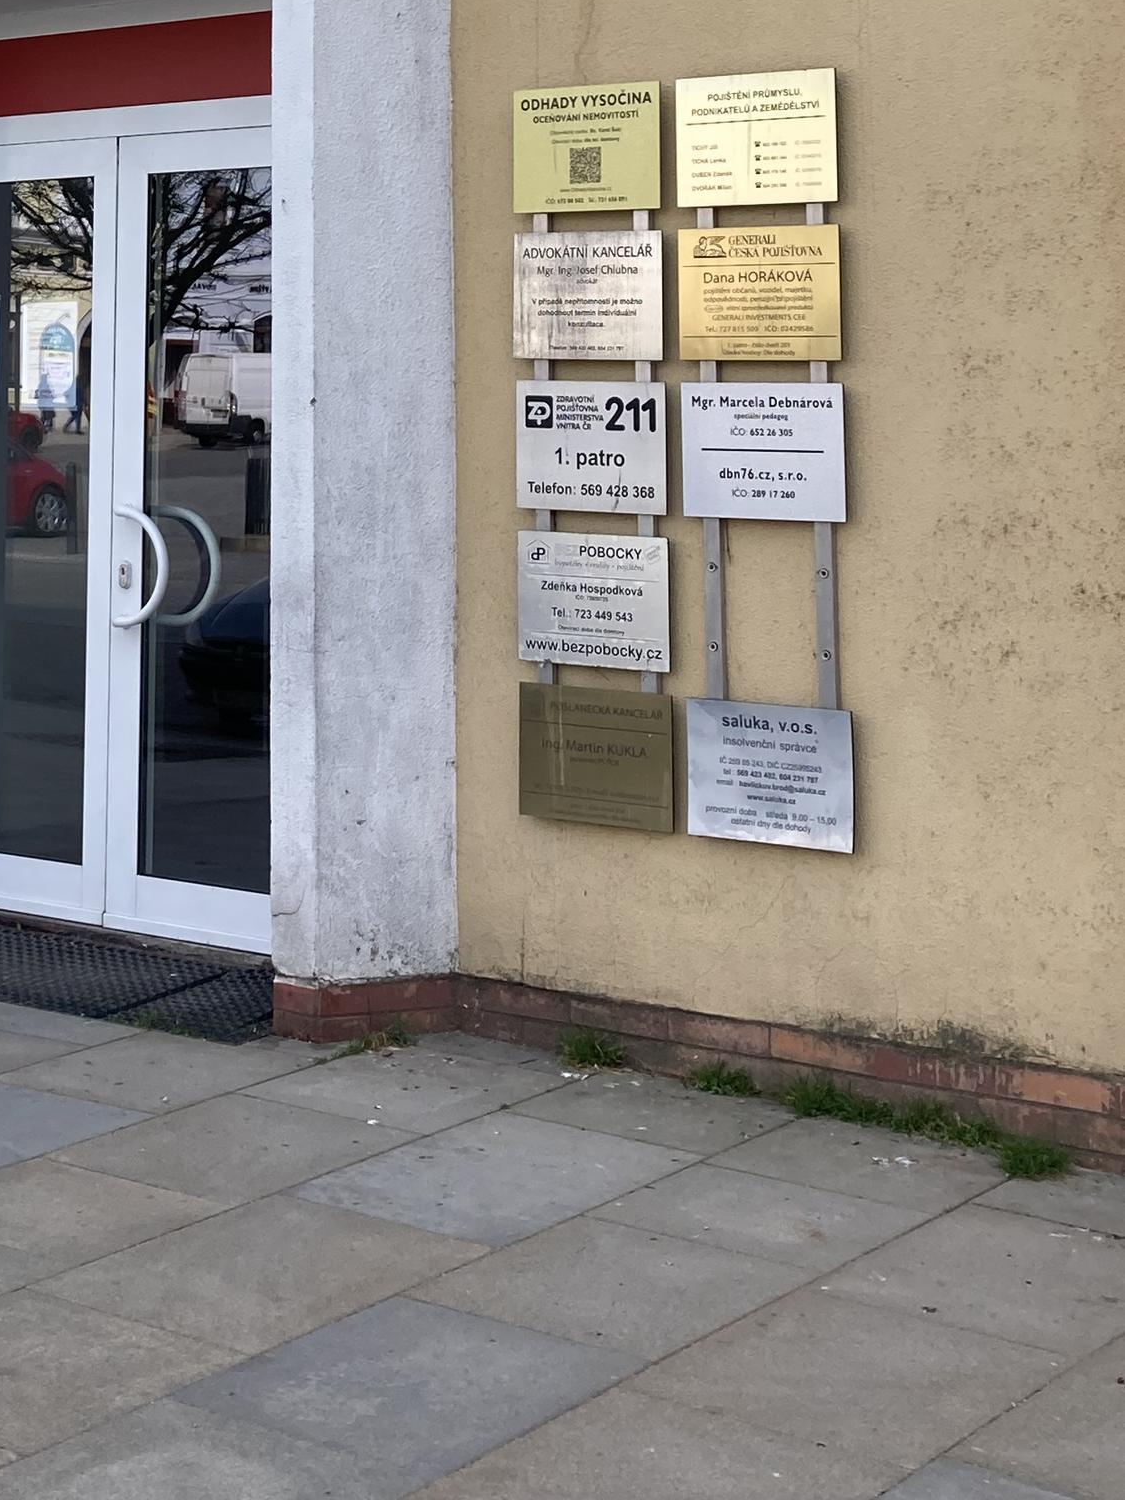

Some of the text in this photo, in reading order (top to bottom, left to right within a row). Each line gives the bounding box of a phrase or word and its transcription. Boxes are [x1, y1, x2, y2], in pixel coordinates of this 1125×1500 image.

[521, 89, 652, 111] ODHADY VYSOČINA
[708, 89, 751, 101] POJIŠTĚNÍ
[691, 105, 750, 116] PODNIKATELŮ
[760, 99, 820, 112] ZEMĚDĚLSTVÍ
[533, 109, 639, 124] OCEŇOVÁNÍ NEMOVITOSTÍ
[729, 234, 776, 244] GENERALI
[523, 243, 652, 259] ADVOKÁTNÍ KANCELÁŘ
[728, 244, 822, 258] ČESKÁ POJIŠŤOVNA
[576, 265, 598, 275] Josef
[601, 265, 638, 274] Chlubna
[704, 268, 813, 283] Dana HORÁKOVÁ
[556, 394, 594, 402] ZDRAVOTNÍ
[691, 396, 833, 410] Mgr. Marcela Debnárová
[556, 403, 598, 412] POJIŠŤOVNA
[605, 396, 656, 432] 211
[762, 413, 788, 421] pedagog
[582, 421, 591, 430] ČR
[730, 426, 747, 436] IČO:
[555, 448, 625, 469] 1. patro
[719, 468, 807, 482] dbn76.cz, s.r.o.
[528, 481, 655, 499] Telefon: 569 428 368
[732, 489, 795, 498] IČO: 289 17 260
[541, 580, 643, 597] Zdeňka Hospodková
[575, 609, 591, 619] 723
[595, 610, 612, 621] 449
[616, 611, 633, 622] 543
[525, 639, 662, 661] www.bezpobocky.cz
[722, 714, 817, 735] saluka, v.o.s.
[566, 740, 603, 753] Martin
[607, 744, 646, 757] KUKLA
[723, 736, 817, 753] insolvenční správce
